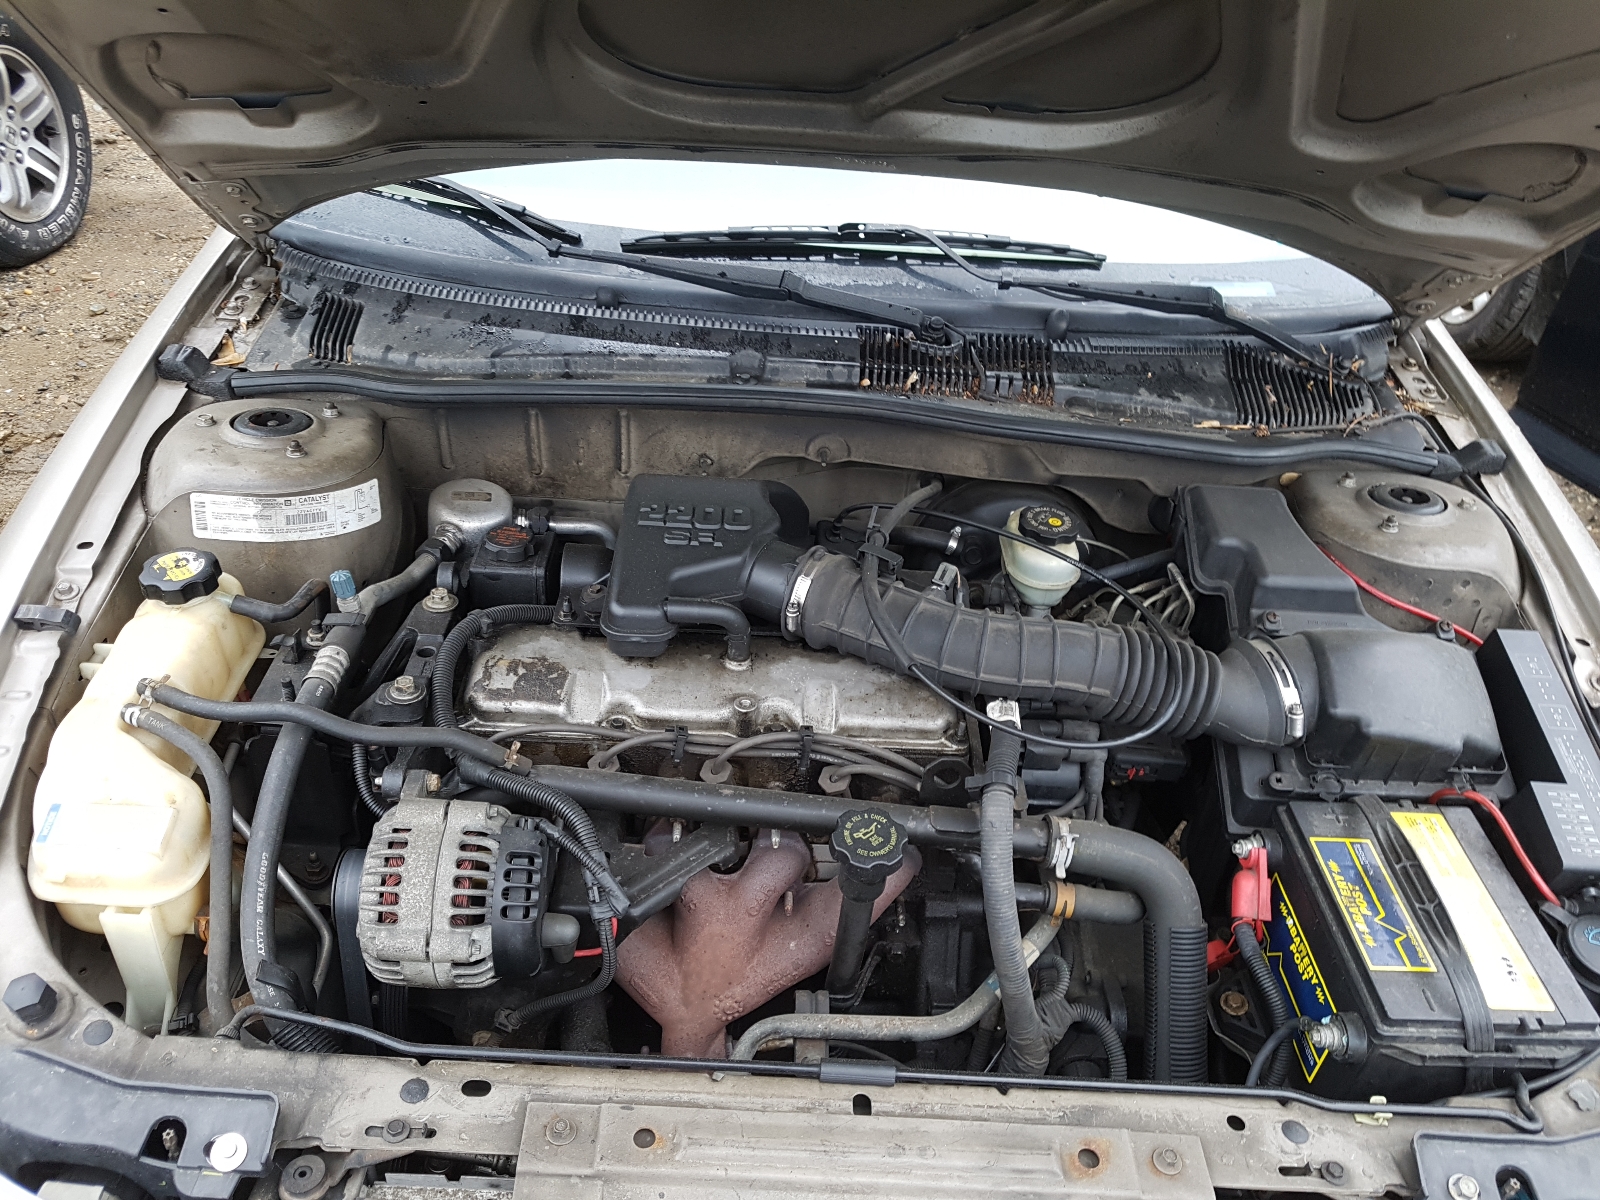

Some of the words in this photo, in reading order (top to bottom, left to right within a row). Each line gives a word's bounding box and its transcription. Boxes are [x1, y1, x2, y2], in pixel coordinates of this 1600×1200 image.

[37, 114, 87, 240] SCRAMBLER
[298, 494, 331, 504] CATALYST
[638, 503, 752, 531] 2200
[148, 716, 165, 731] TANK
[851, 814, 862, 822] FILL
[870, 813, 888, 824] CHECK
[856, 848, 869, 857] SEE
[1347, 882, 1373, 916] POST
[256, 919, 266, 956] GALAXY
[1289, 943, 1310, 982] POST
